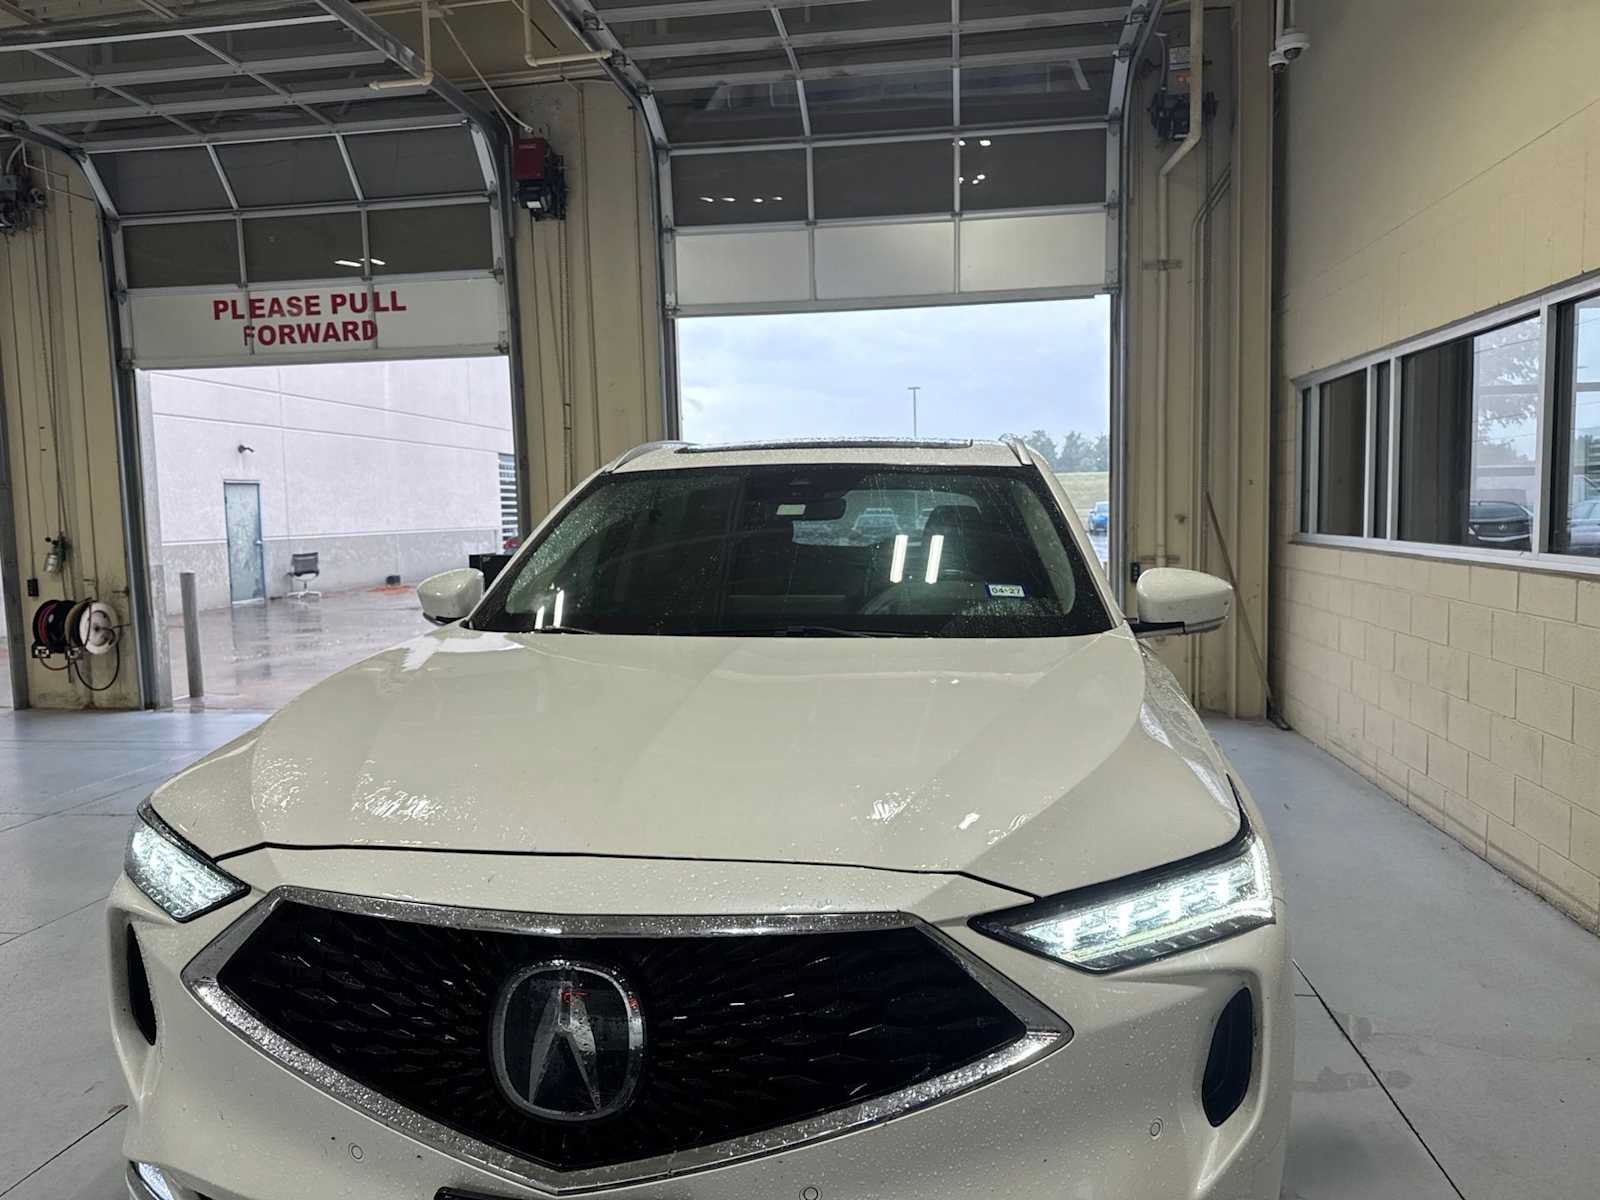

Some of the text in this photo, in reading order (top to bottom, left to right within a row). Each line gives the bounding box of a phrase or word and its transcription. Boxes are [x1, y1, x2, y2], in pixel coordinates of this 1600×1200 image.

[213, 290, 407, 320] PLEASE PULL
[243, 319, 379, 347] FORWARD
